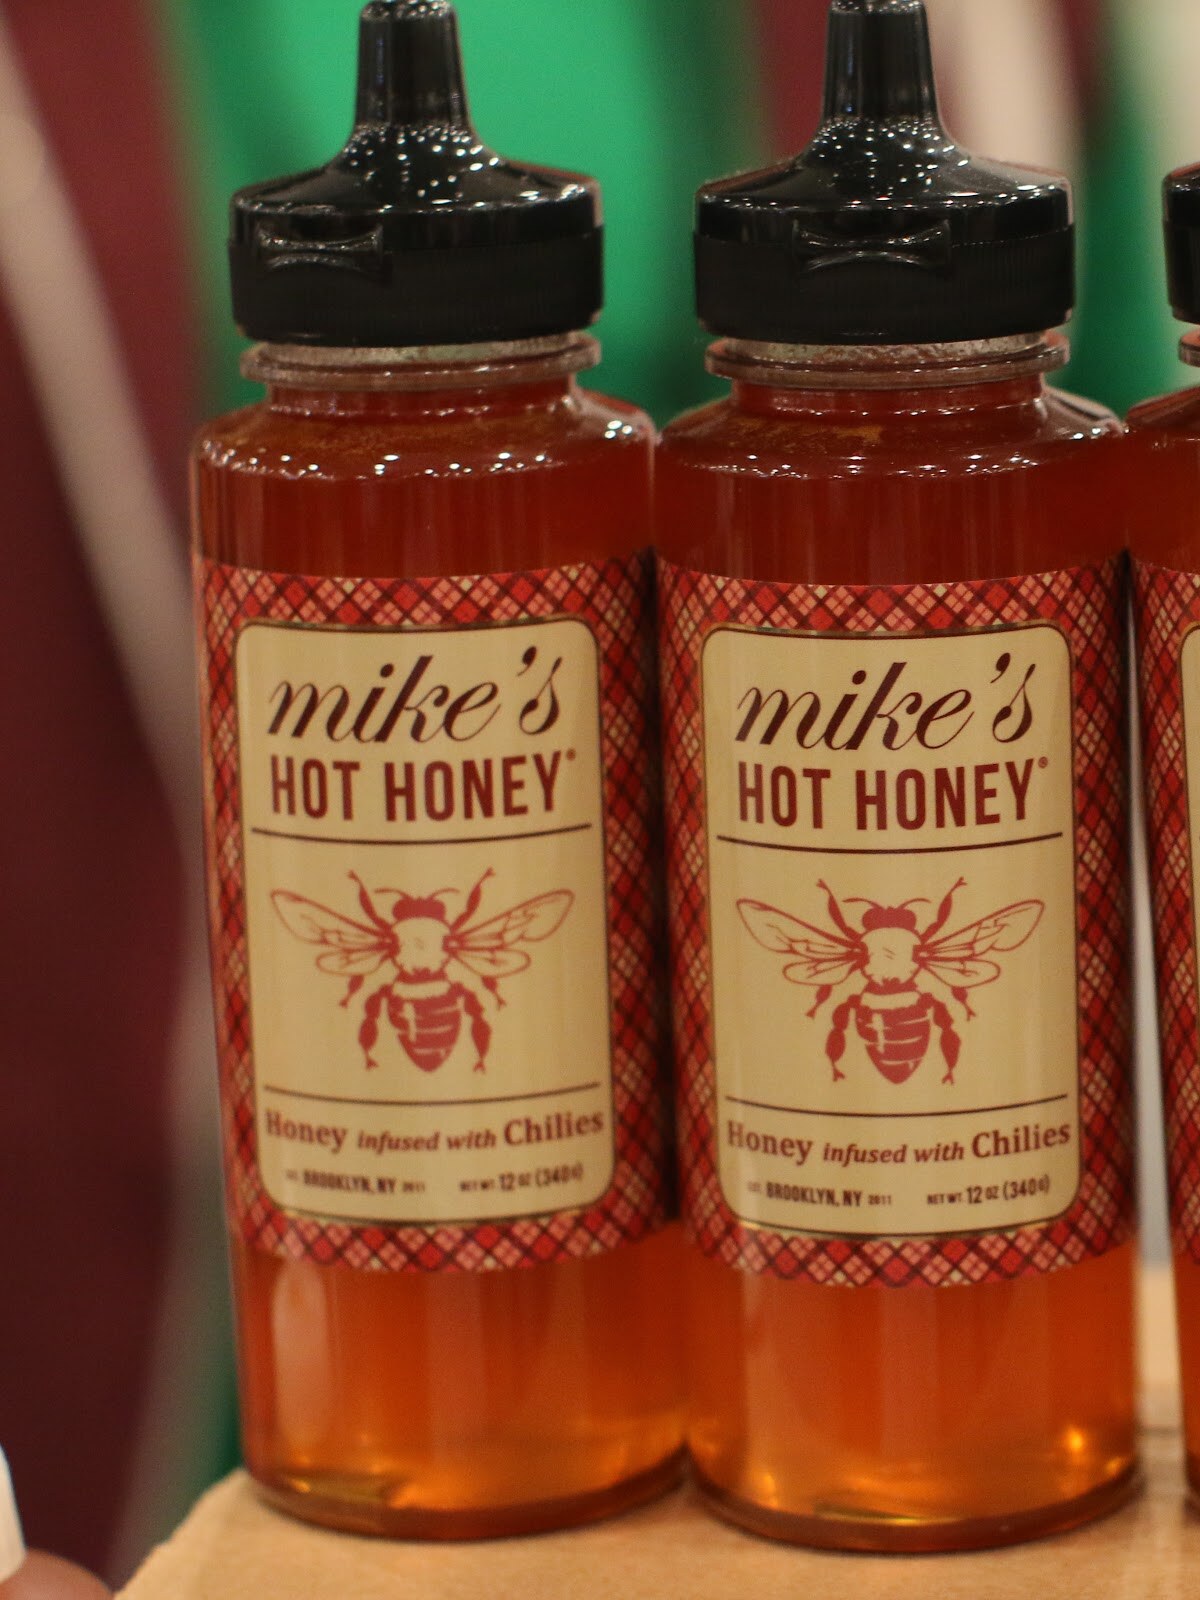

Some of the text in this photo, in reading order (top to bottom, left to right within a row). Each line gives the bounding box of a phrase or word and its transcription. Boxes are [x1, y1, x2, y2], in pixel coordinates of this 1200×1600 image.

[267, 646, 562, 742] mike's
[734, 652, 1036, 751] mike's
[271, 755, 360, 820] HOT
[738, 760, 831, 829] HOT
[265, 1108, 603, 1155] Honey infused with Chilies
[727, 1120, 1071, 1167] Honey infused with Chilies
[843, 1189, 862, 1206] NY
[966, 1184, 982, 1204] 12
[985, 1185, 999, 1200] OZ
